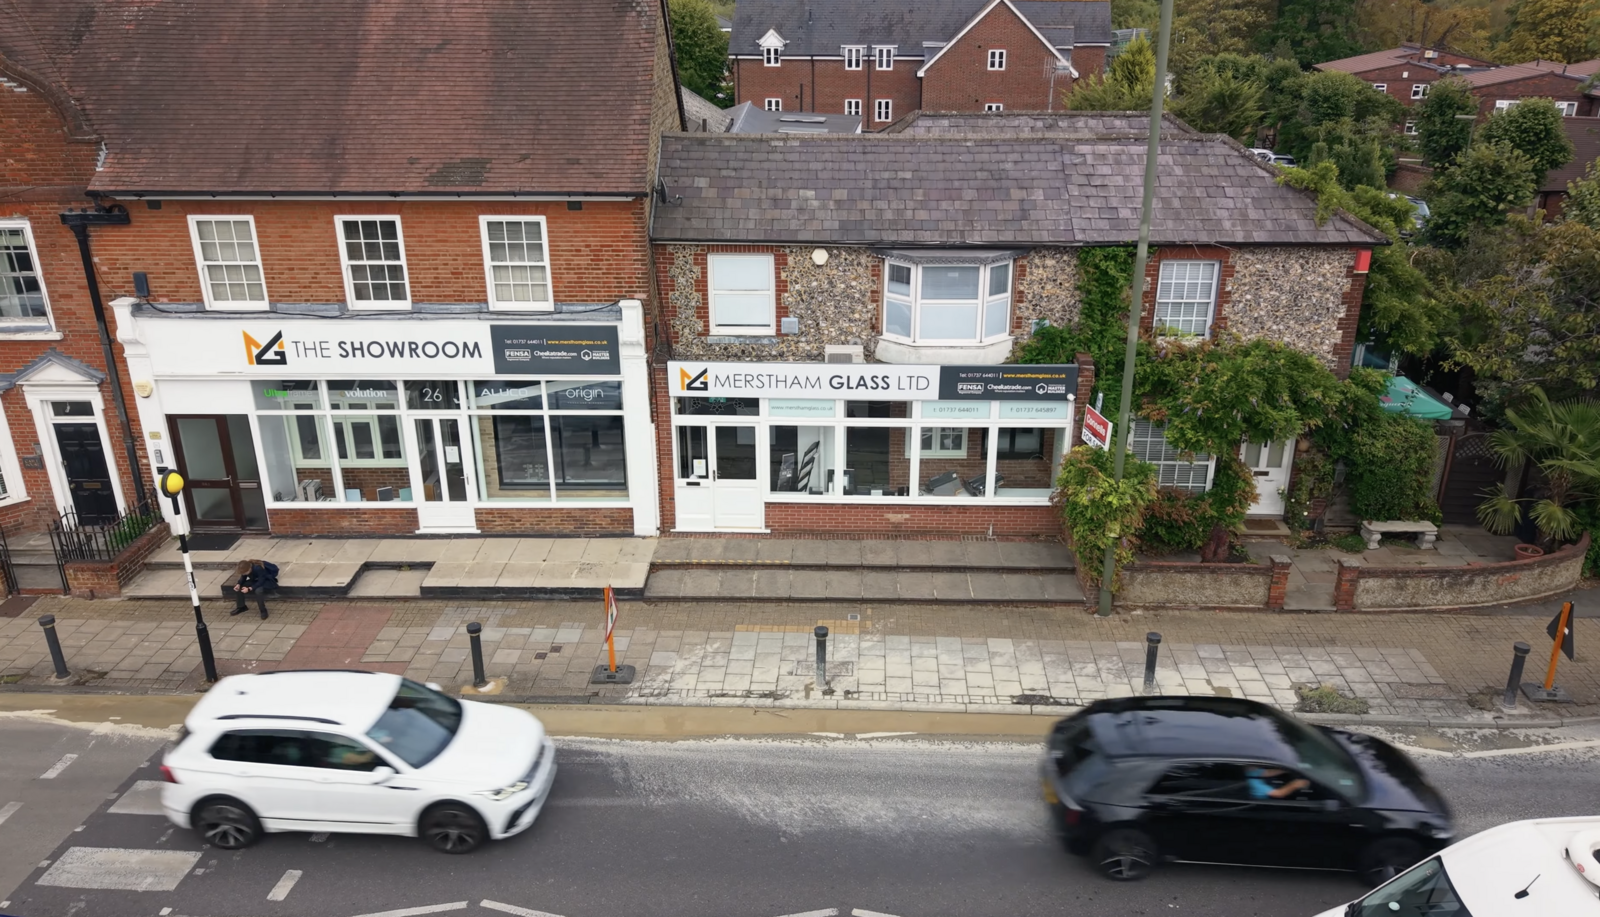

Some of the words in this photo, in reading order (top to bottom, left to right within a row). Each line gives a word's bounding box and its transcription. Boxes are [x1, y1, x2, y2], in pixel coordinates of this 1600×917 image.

[291, 340, 332, 358] THE
[338, 340, 483, 359] SHOWROOM
[714, 373, 822, 390] MERSTHAM
[828, 374, 891, 391] GLASS
[897, 375, 931, 391] LTD
[339, 387, 388, 398] evolution
[422, 387, 443, 402] 26
[480, 388, 528, 398] ALUCO
[565, 386, 604, 402] origin
[771, 404, 834, 412] www.mersthamglass.co.uk
[1086, 413, 1106, 437] Connells
[1083, 430, 1093, 443] FOR
